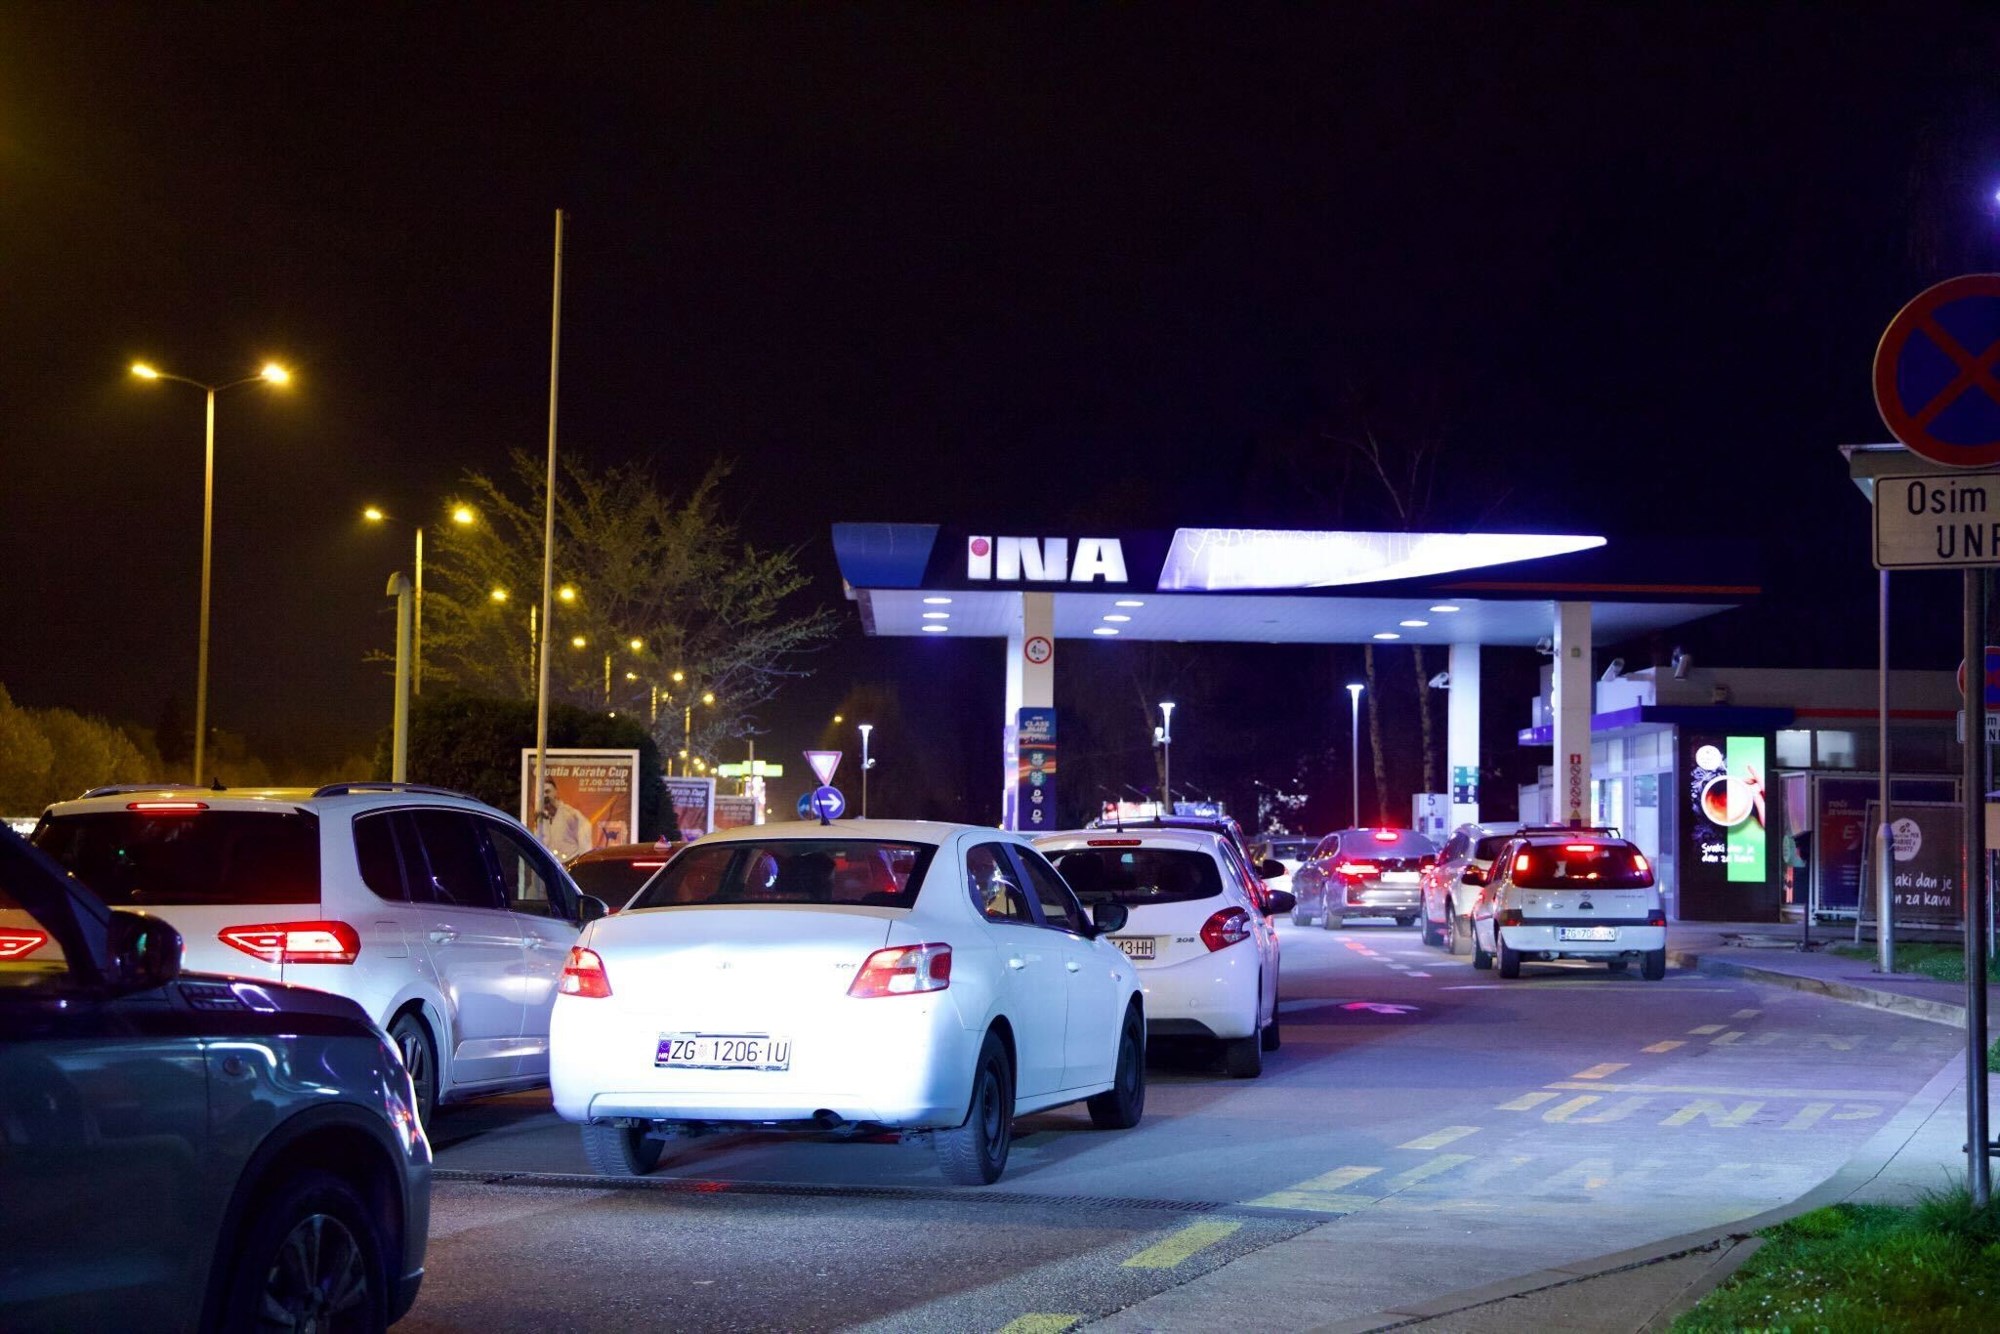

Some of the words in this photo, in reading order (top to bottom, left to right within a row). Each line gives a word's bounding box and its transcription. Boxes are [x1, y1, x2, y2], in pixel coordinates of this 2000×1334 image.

[1907, 480, 1986, 516] Osim
[534, 766, 570, 777] oatia
[572, 766, 606, 777] Karate
[608, 766, 629, 779] Cup
[1428, 793, 1436, 806] 5
[1894, 872, 1912, 887] aki
[1915, 871, 1938, 888] dan
[1940, 874, 1953, 892] je
[1905, 893, 1920, 906] za
[1924, 891, 1951, 907] kavu
[671, 1040, 696, 1060] ZG
[1541, 1094, 1882, 1131] UNP
